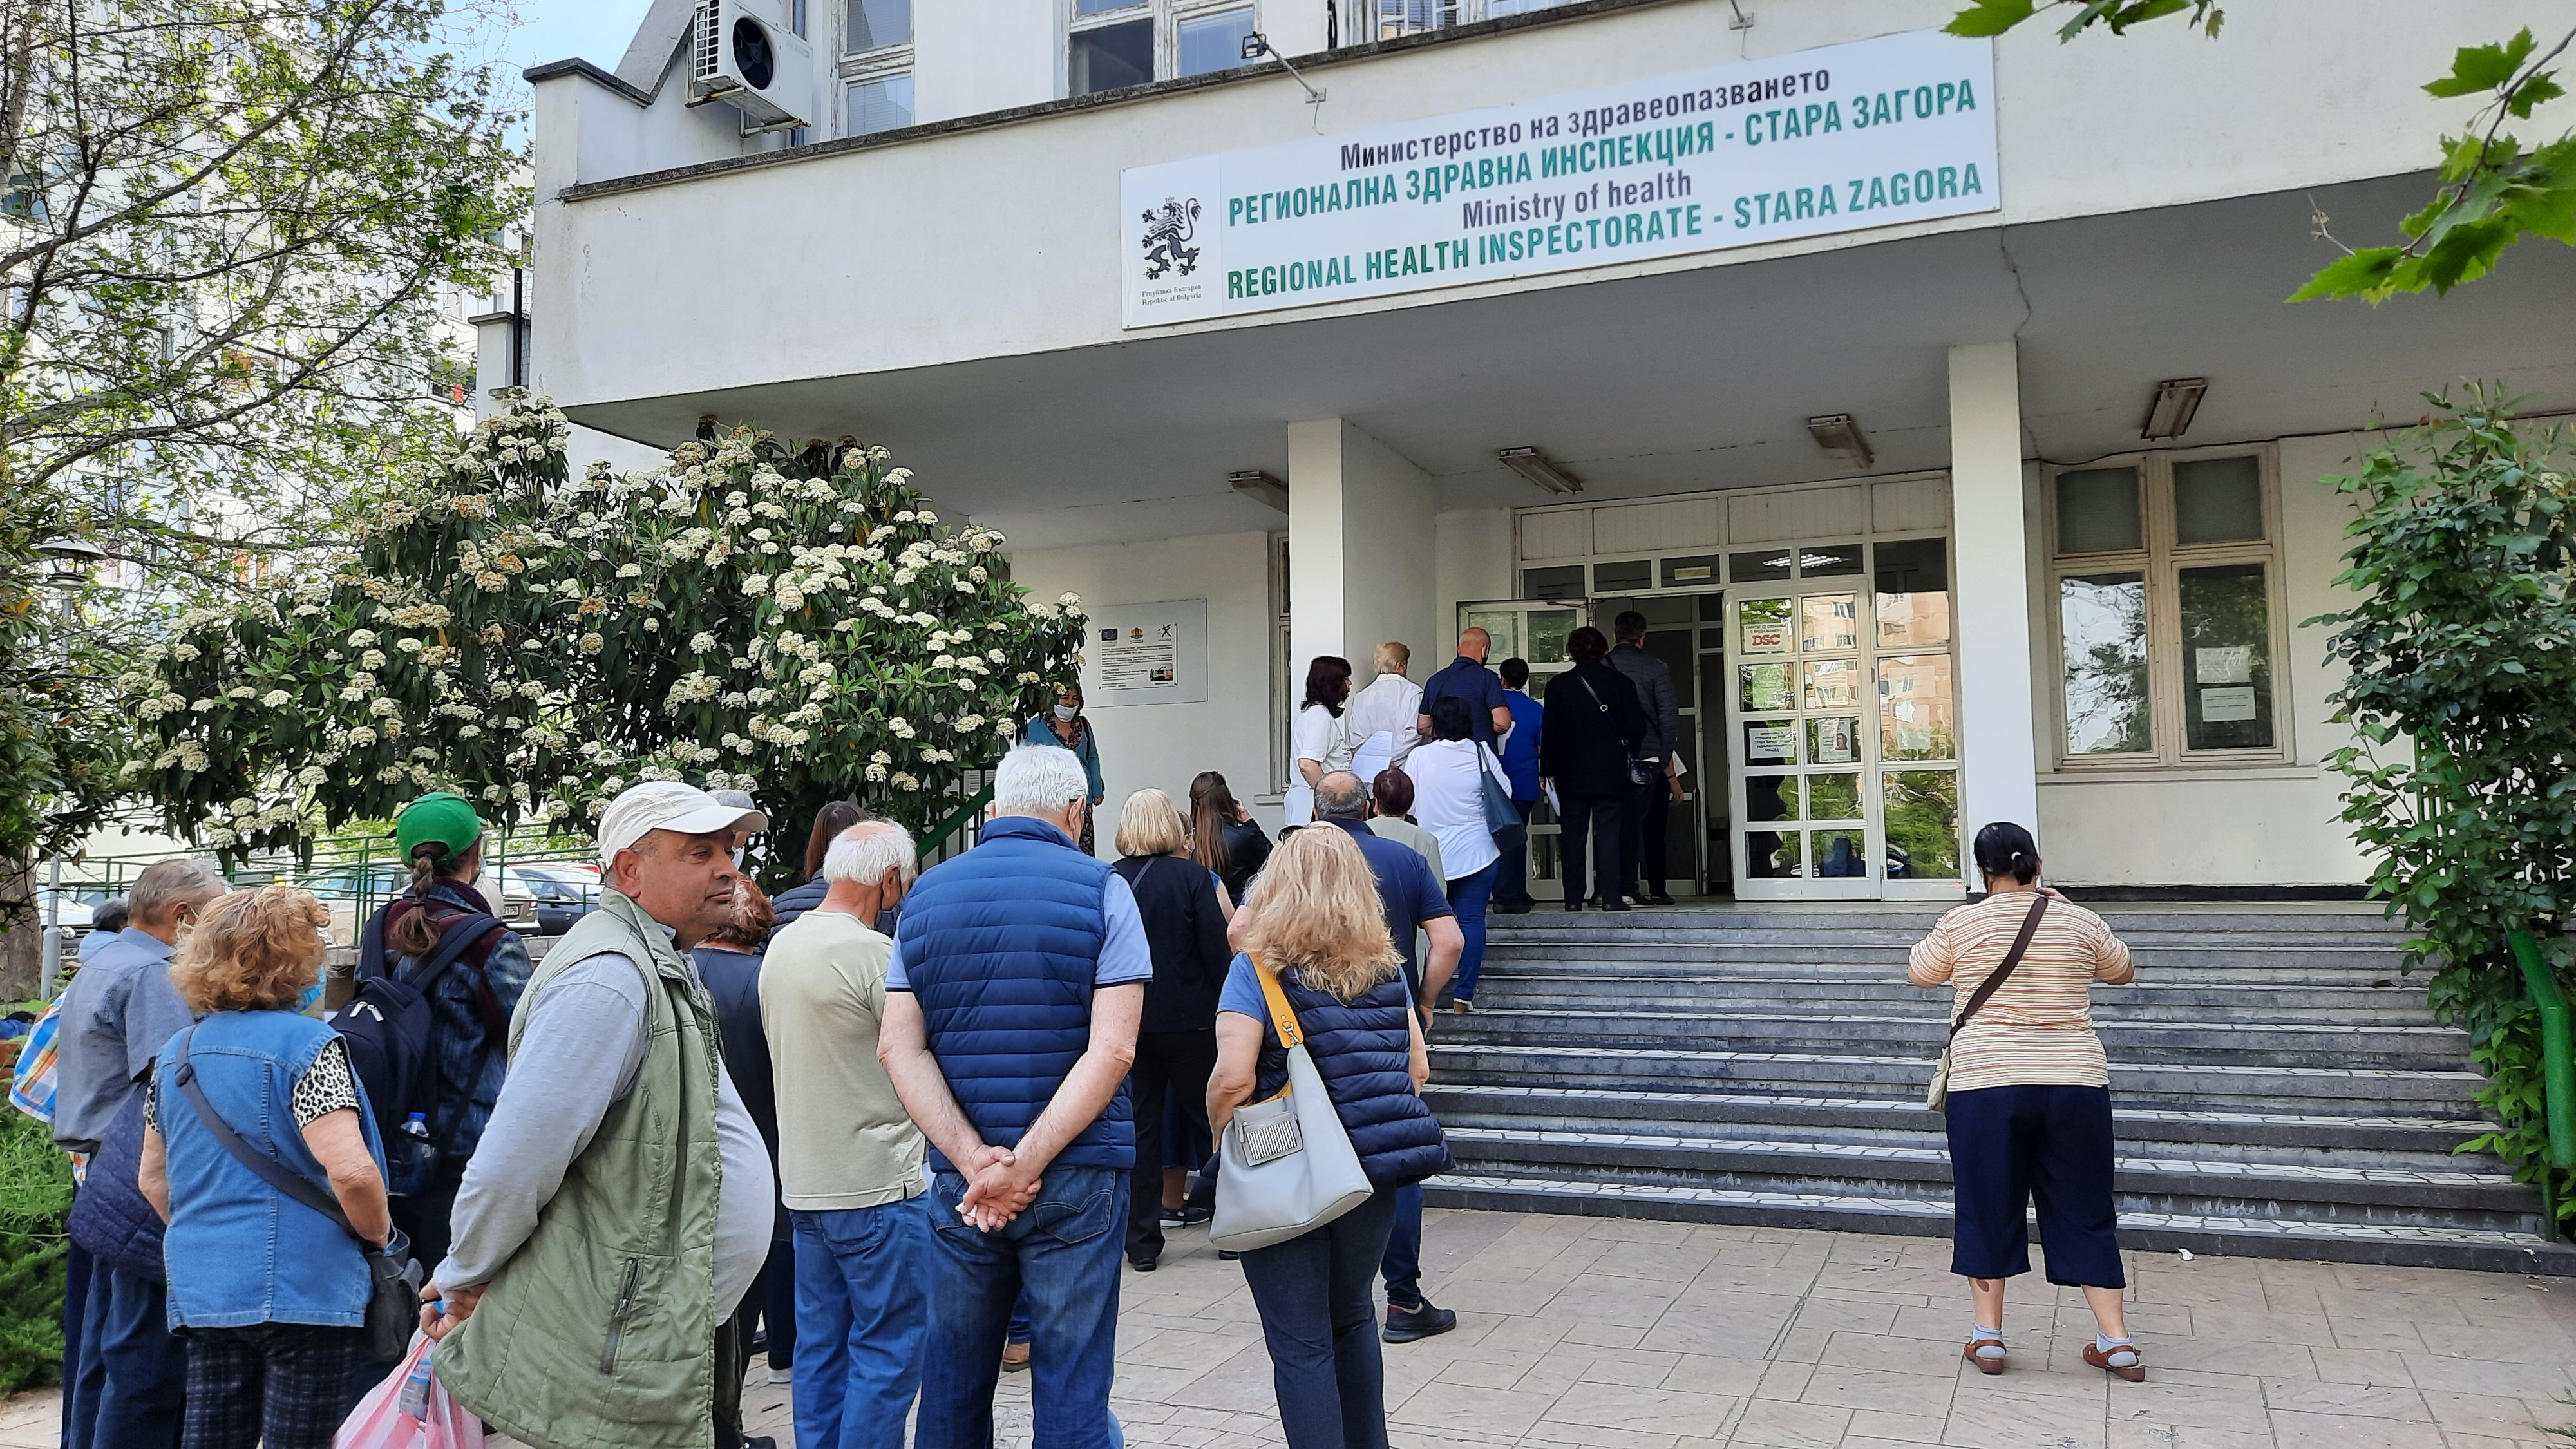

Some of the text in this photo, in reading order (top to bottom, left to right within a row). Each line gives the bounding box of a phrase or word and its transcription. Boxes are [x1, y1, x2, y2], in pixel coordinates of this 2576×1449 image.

[1229, 173, 1398, 227] РЕГИОНАЛНА
[1406, 151, 1533, 205] ЗДРАВНА
[1541, 120, 1714, 179] ИНСПЕКЦИЯ
[1745, 100, 1843, 146] СТАРА
[1852, 78, 1977, 129] ЗАГОРА
[1341, 69, 1830, 171] Министерство на здравеопазването
[1227, 255, 1357, 300] REGIONAL
[1365, 238, 1469, 281] HEALTH
[1479, 204, 1702, 265] INSPECTORATE
[1734, 184, 1838, 229] STARA
[1848, 162, 1982, 213] ZAGORA
[1463, 169, 1691, 229] Ministry of health
[1142, 297, 1168, 306] Republic
[1177, 292, 1202, 301] Bulgaria
[1752, 634, 1781, 646] DSC
